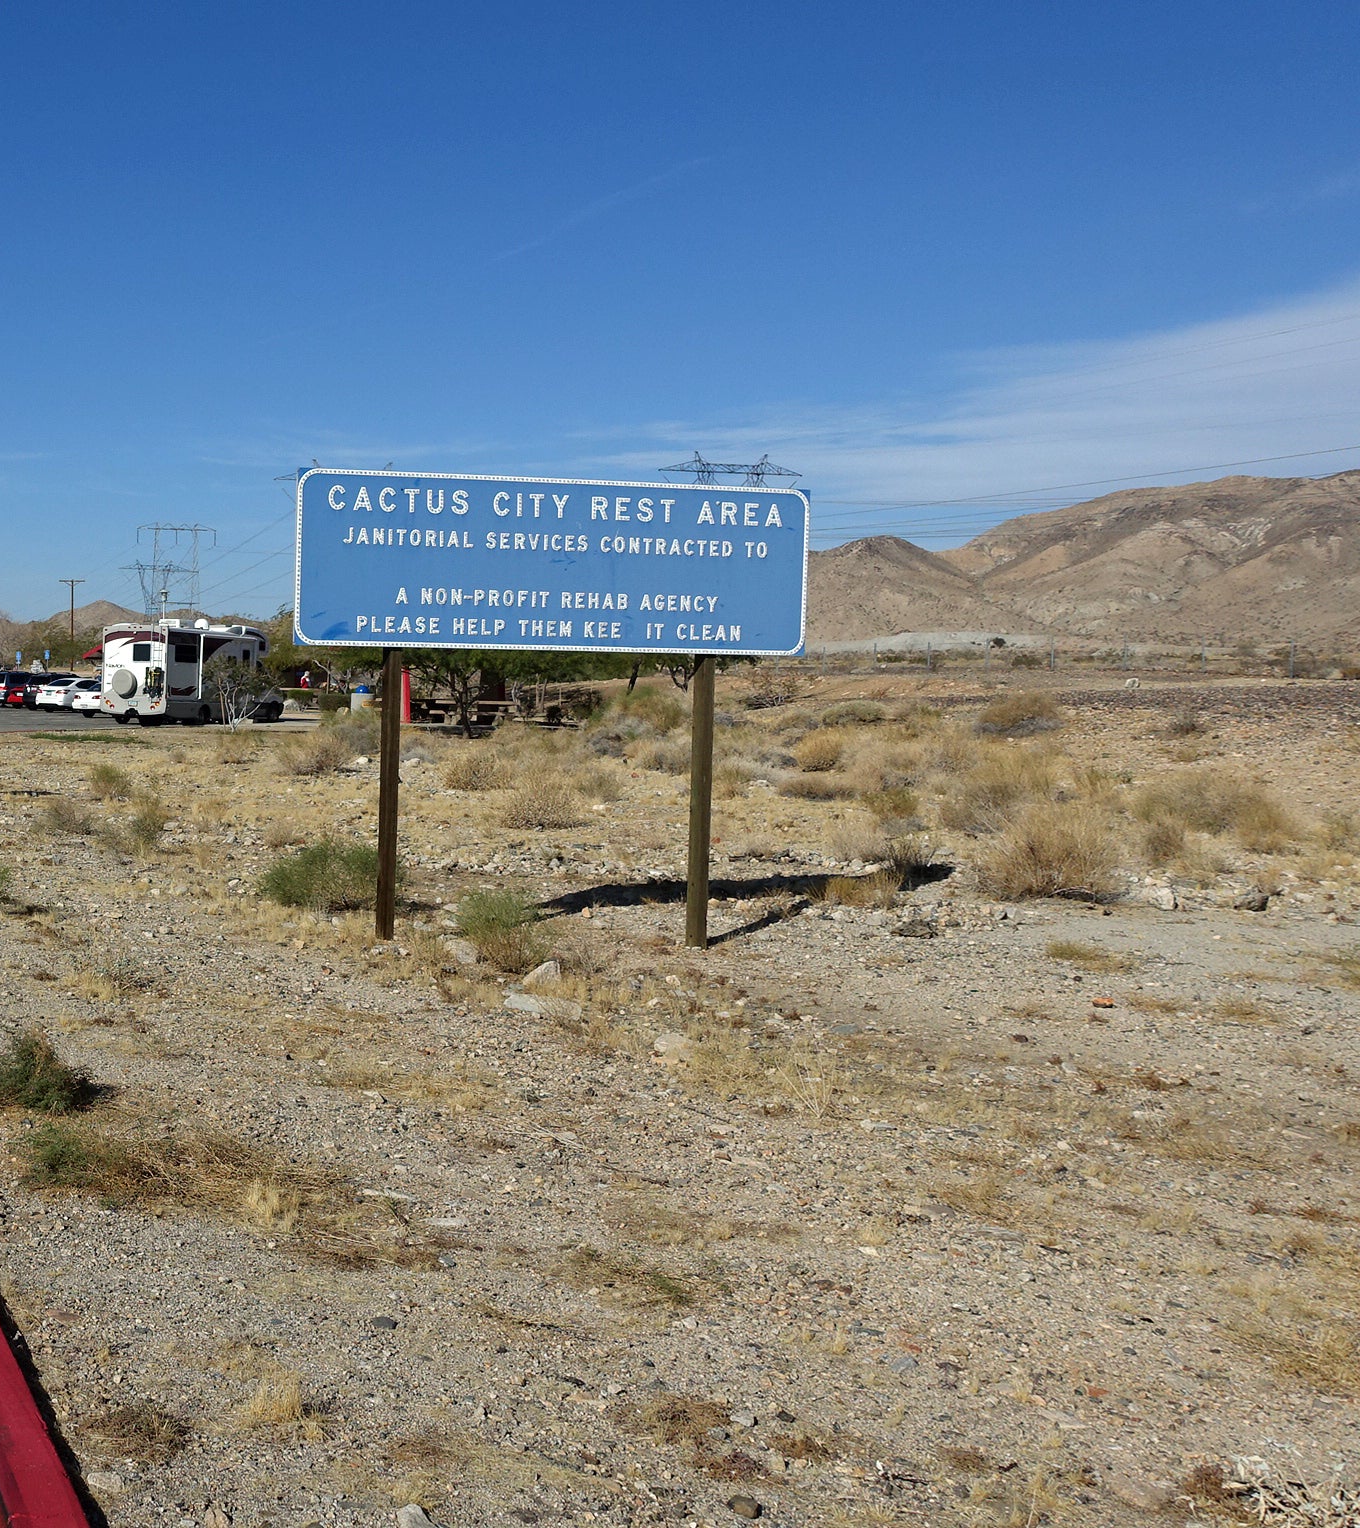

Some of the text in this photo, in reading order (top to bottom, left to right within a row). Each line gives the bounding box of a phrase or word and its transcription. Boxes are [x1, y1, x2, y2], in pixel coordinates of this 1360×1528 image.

[328, 485, 783, 528] CACTUS CITY REST AREA
[343, 526, 768, 558] JANITORIAL SERVICES CONTRACTED TO
[395, 587, 719, 613] A NON-PROFIT REHAB AGENCY
[356, 615, 440, 635] PLEASE
[453, 617, 506, 636] HELP
[518, 619, 573, 638] THEM
[646, 623, 665, 640] IT
[676, 623, 741, 642] CLEAN
